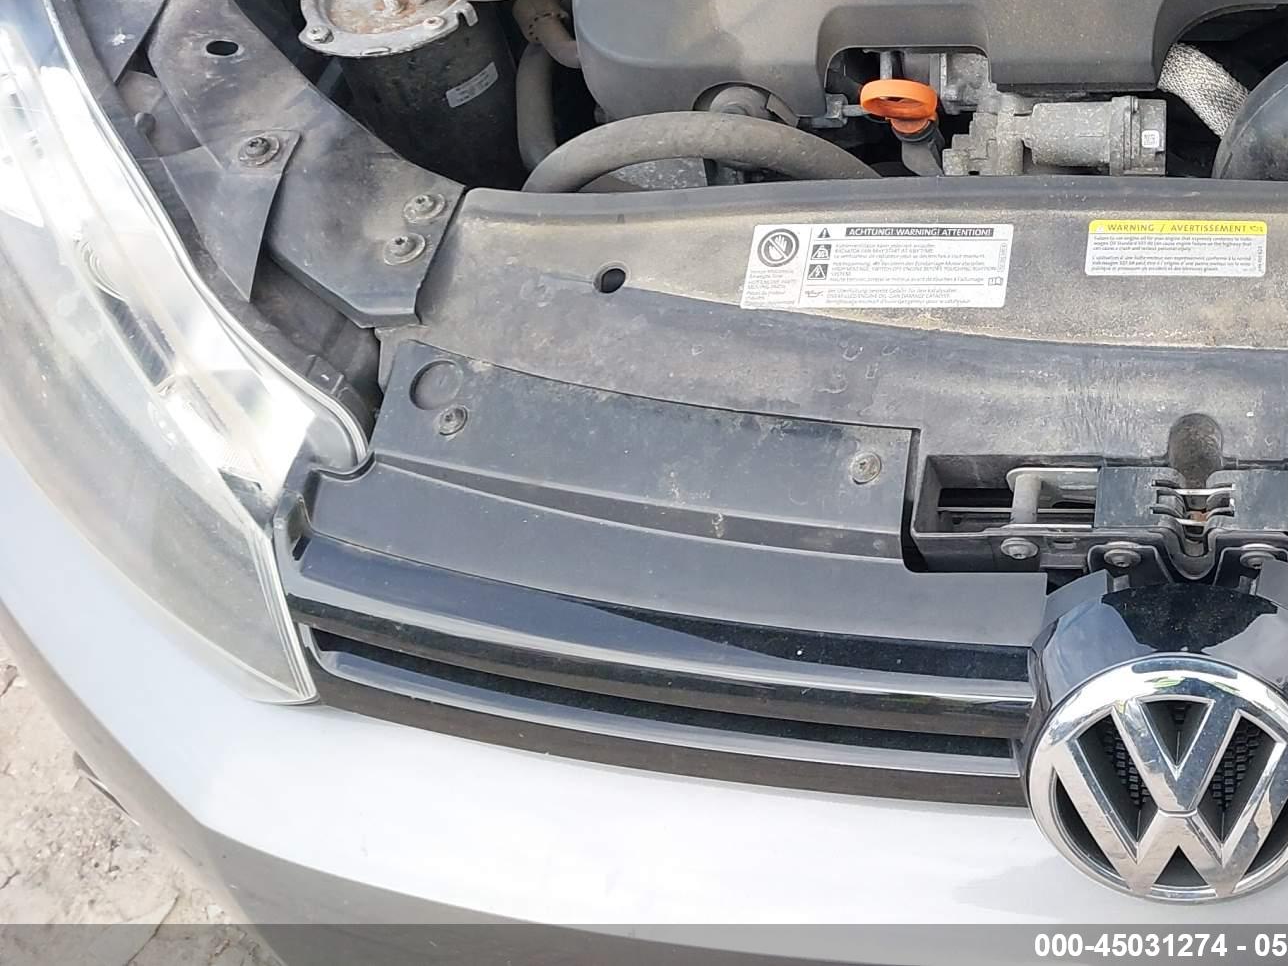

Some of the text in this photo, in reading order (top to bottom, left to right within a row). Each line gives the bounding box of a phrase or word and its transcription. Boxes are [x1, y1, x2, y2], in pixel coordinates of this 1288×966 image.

[849, 228, 991, 236] ACHTUNG! WARNING! ATTENTION!
[1107, 224, 1154, 232] WARNING
[1171, 224, 1246, 232] AVERTISSEMENT
